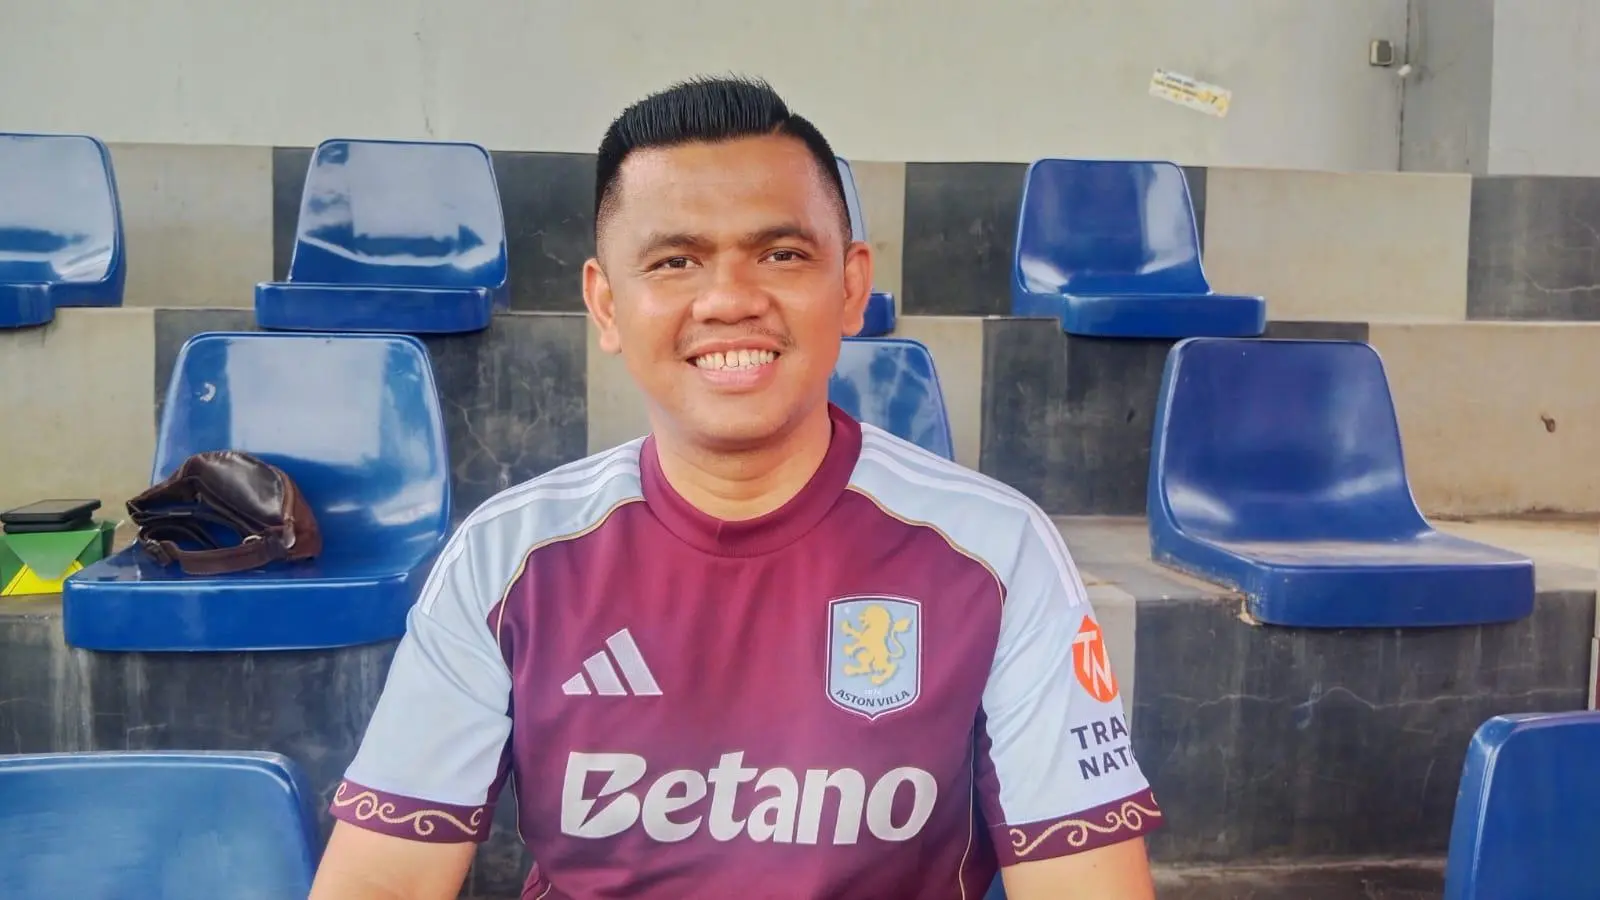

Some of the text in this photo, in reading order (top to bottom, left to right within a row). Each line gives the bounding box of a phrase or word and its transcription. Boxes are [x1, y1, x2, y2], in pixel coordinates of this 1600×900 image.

[836, 689, 875, 706] ASTON
[877, 690, 910, 706] VILLA
[1070, 714, 1128, 749] TRA
[561, 751, 938, 844] Betano
